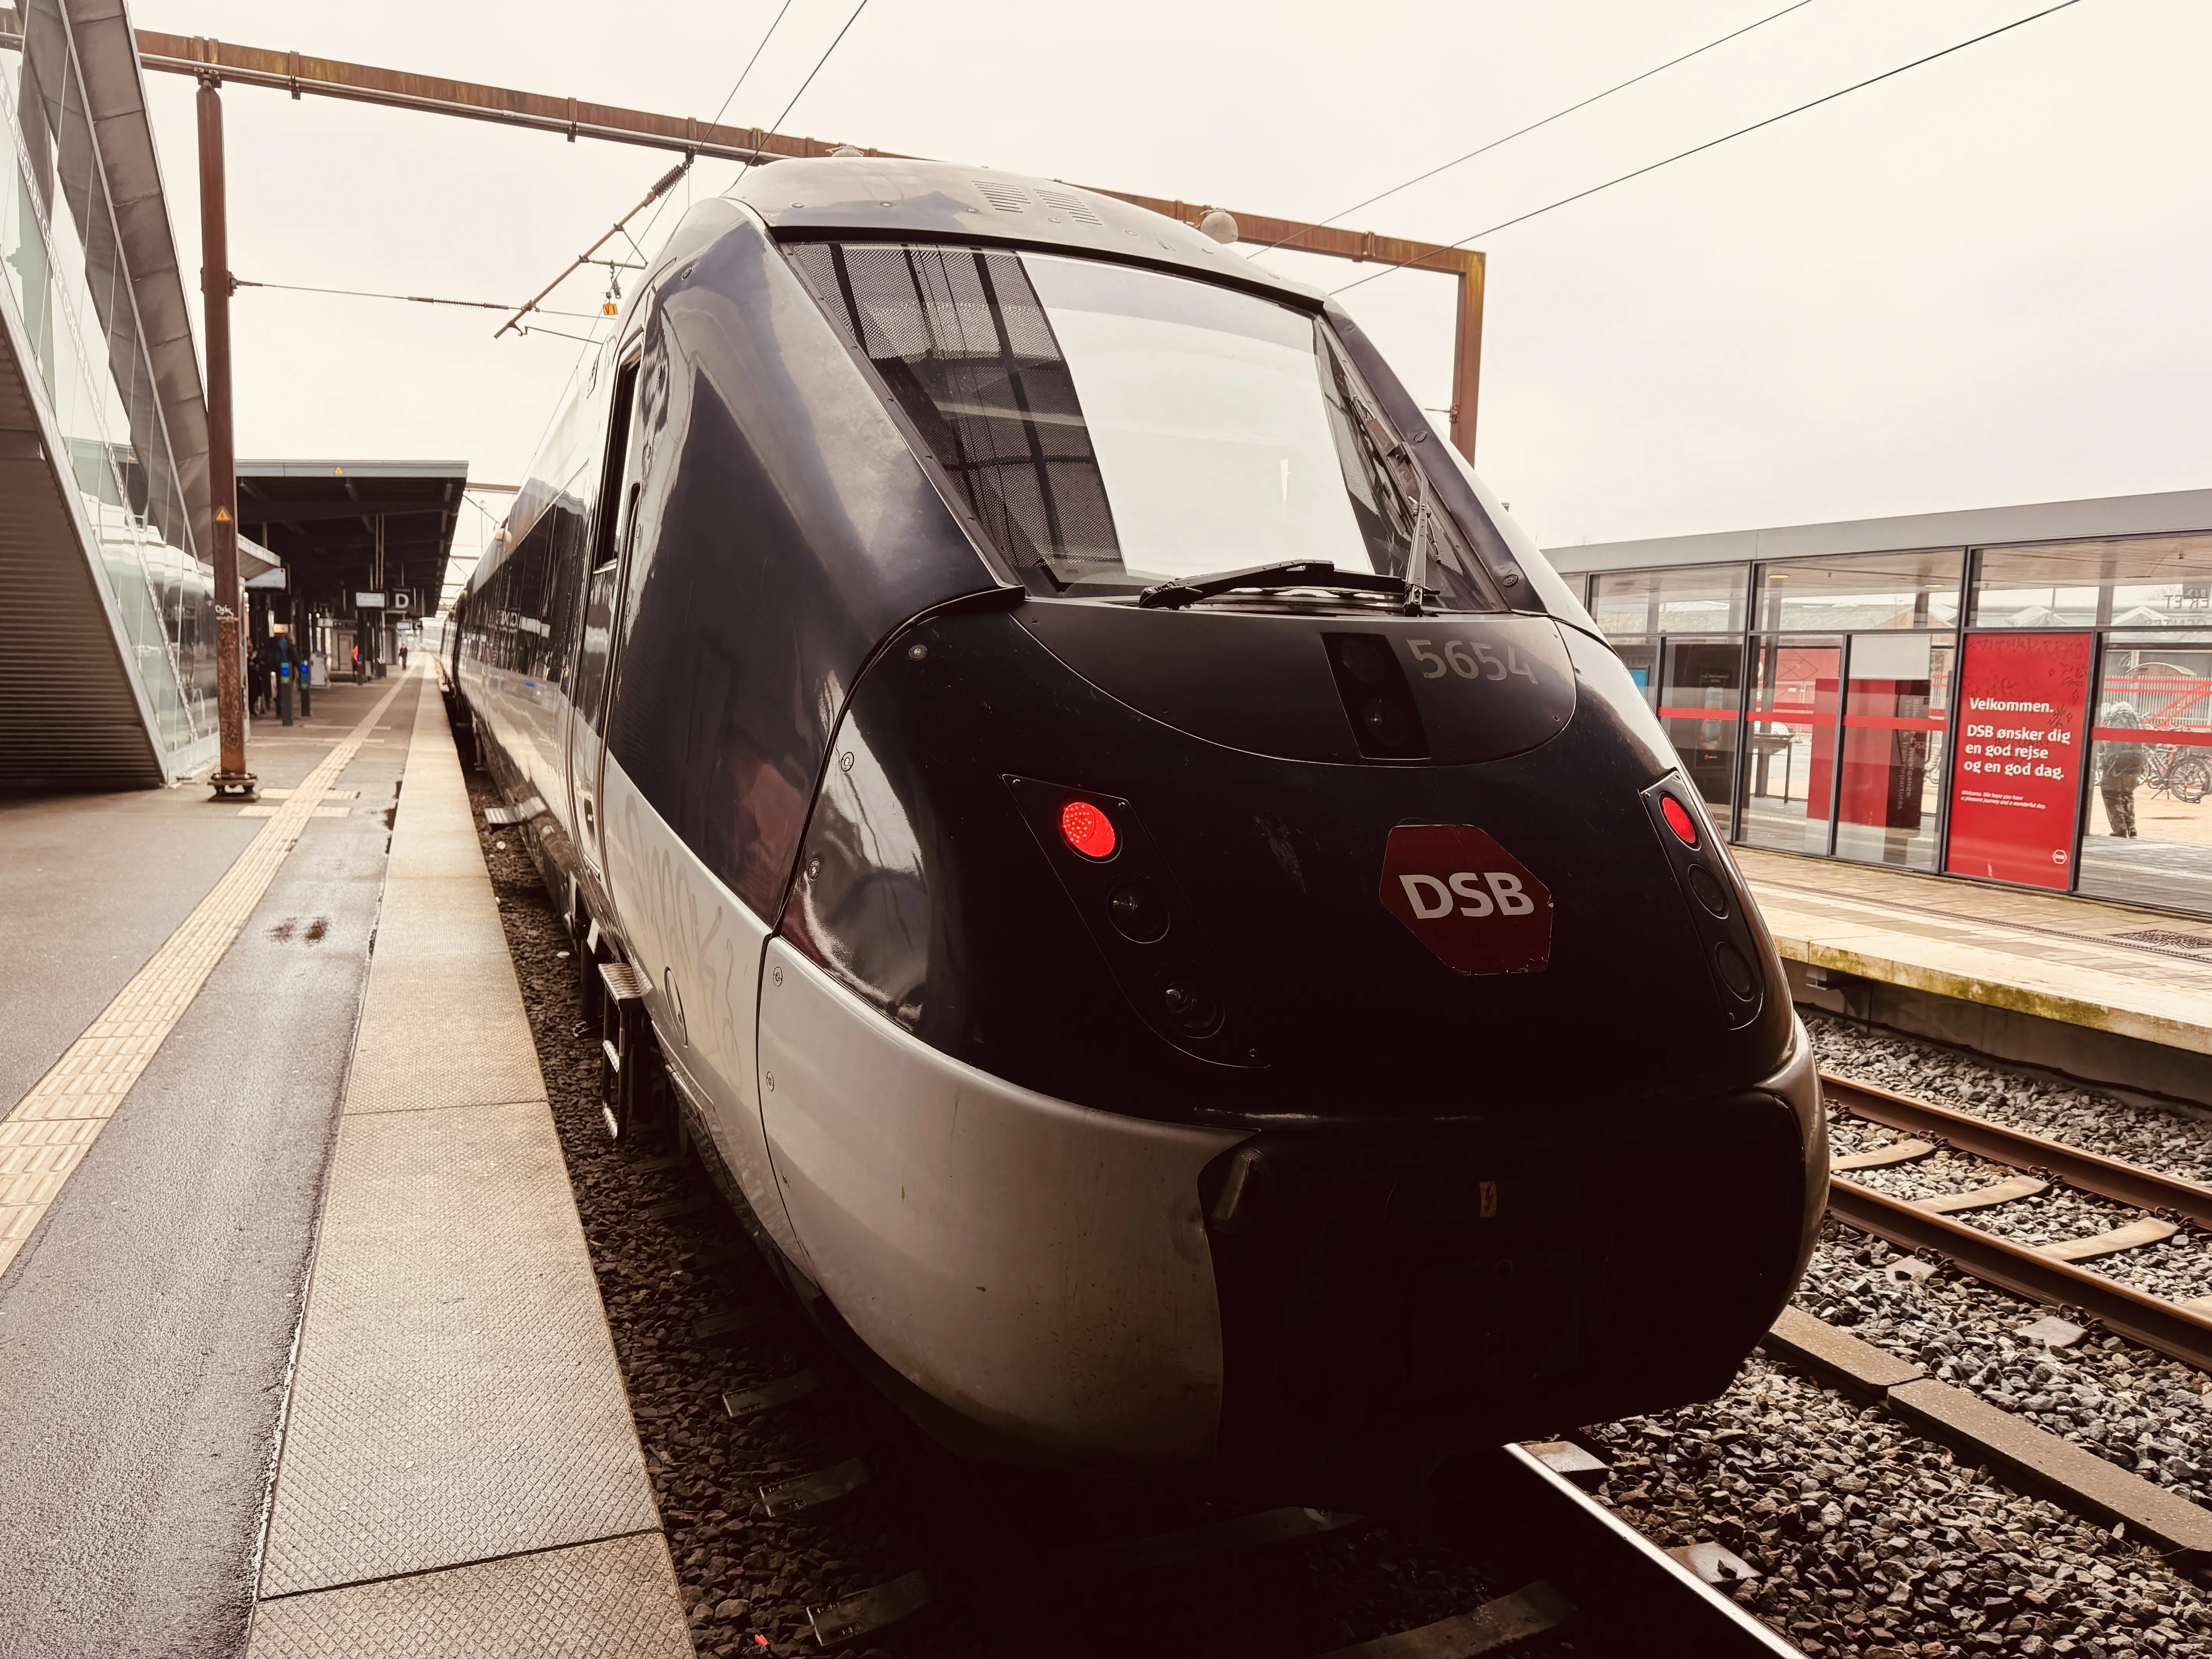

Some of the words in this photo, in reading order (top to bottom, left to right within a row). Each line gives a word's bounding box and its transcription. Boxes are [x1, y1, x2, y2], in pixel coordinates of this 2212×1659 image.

[5, 94, 41, 219] BANEGÅRD
[42, 217, 63, 296] CENTER
[64, 292, 85, 369] ODENSE
[395, 593, 409, 608] D
[1407, 639, 1539, 684] 5654
[1969, 697, 2054, 713] Velkommen.
[1967, 724, 1994, 738] DSB
[1997, 727, 2045, 741] ønsker
[2047, 728, 2071, 745] dig
[1901, 741, 1909, 762] Train
[1965, 744, 1981, 754] en
[1985, 744, 2011, 757] god
[2014, 745, 2049, 760] rejse
[1964, 761, 1981, 774] og
[1984, 763, 2001, 773] en
[2004, 762, 2031, 776] god
[2034, 764, 2064, 780] dag.
[1898, 764, 1907, 810] departures
[1399, 872, 1534, 919] DSB
